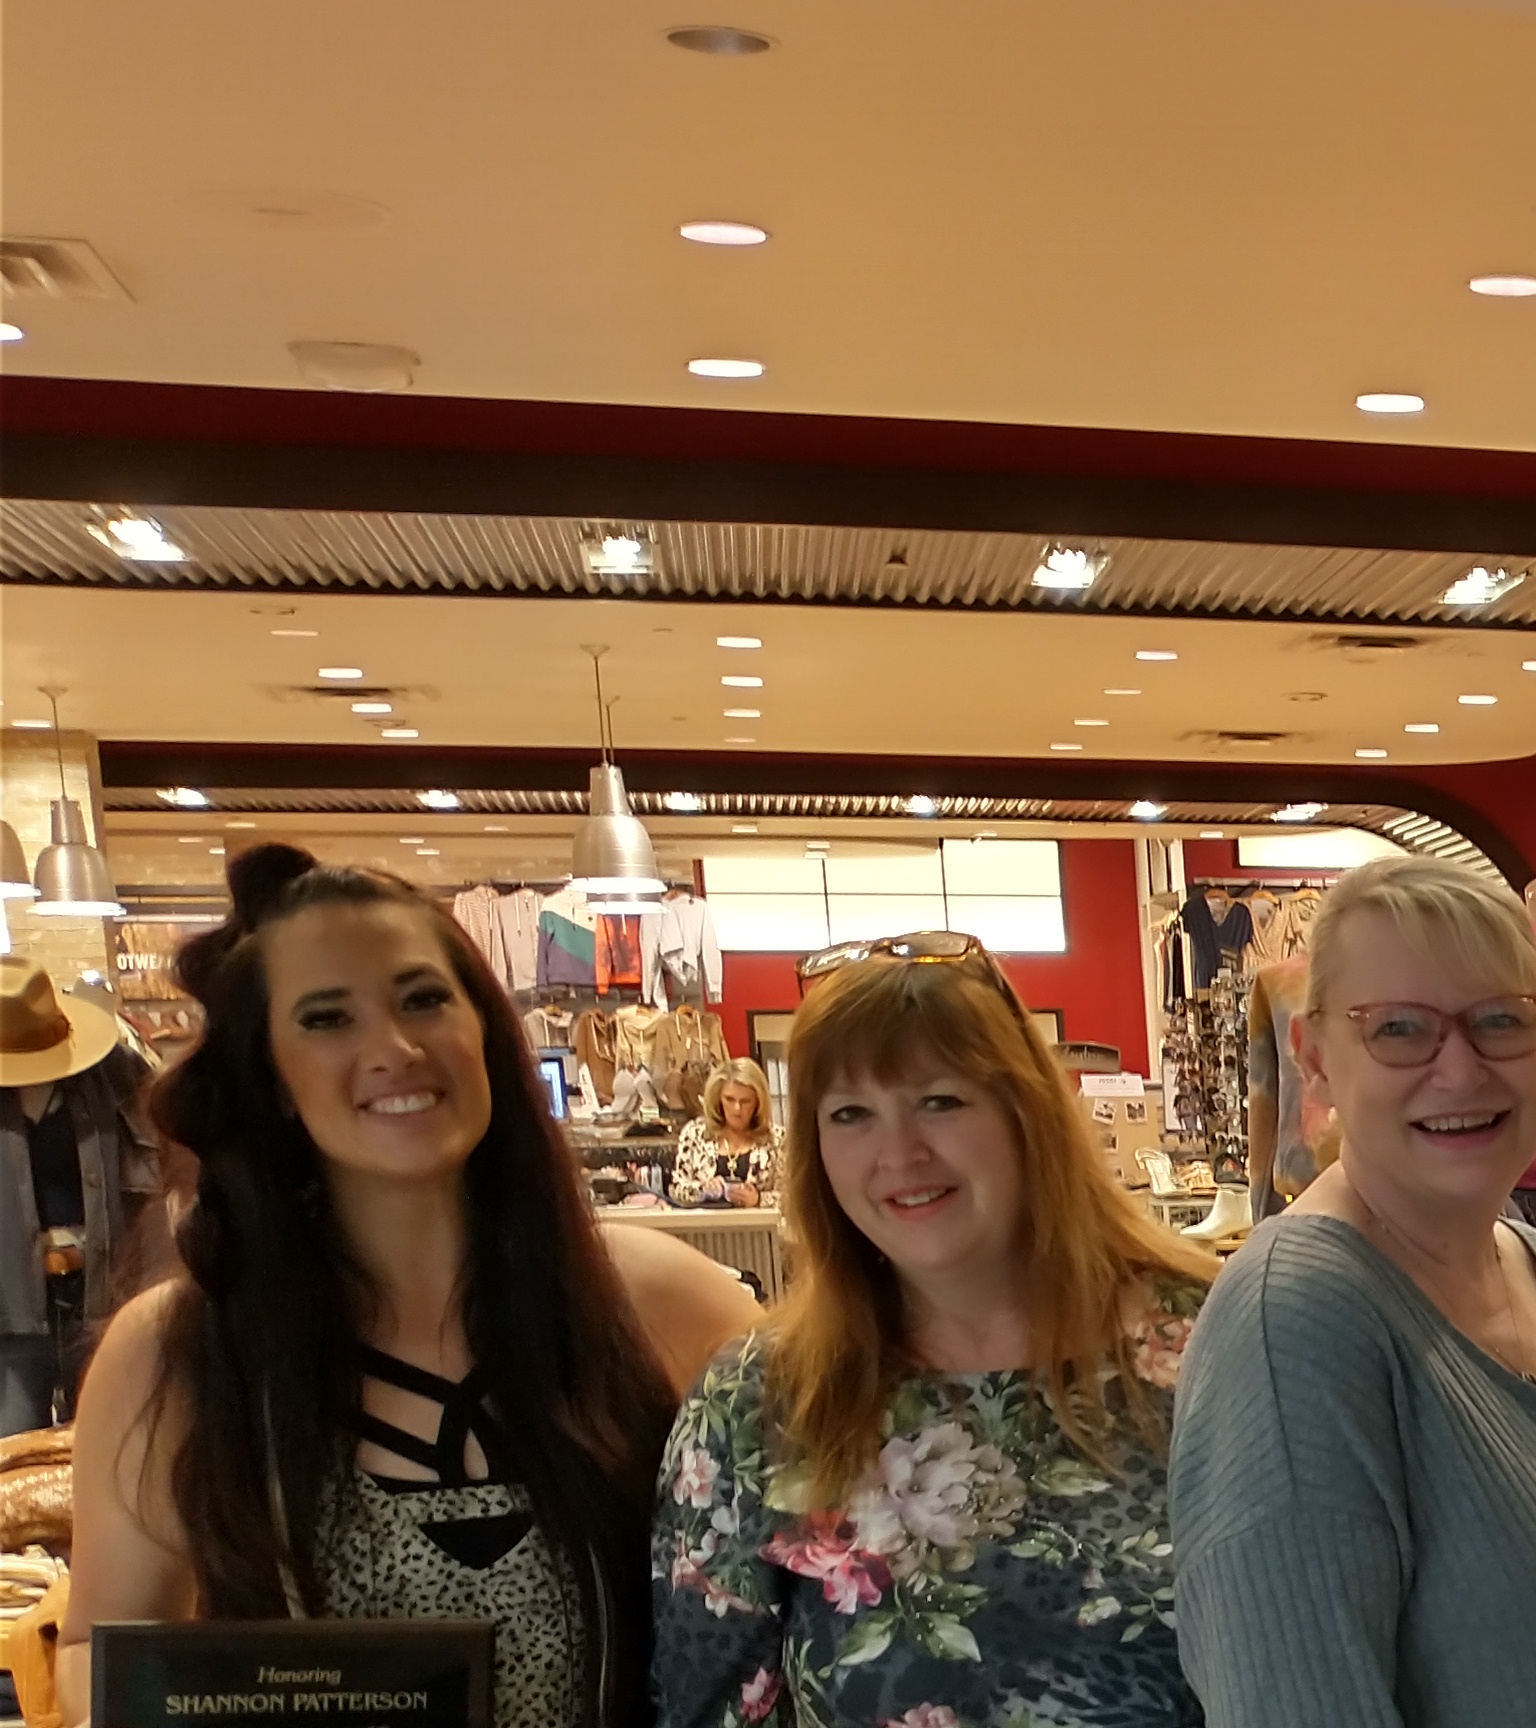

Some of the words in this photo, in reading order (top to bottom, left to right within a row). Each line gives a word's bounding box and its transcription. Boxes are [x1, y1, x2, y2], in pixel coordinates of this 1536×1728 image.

[257, 1666, 342, 1687] Honoring
[165, 1693, 285, 1716] SHANNON
[293, 1690, 429, 1712] PATTERSON
